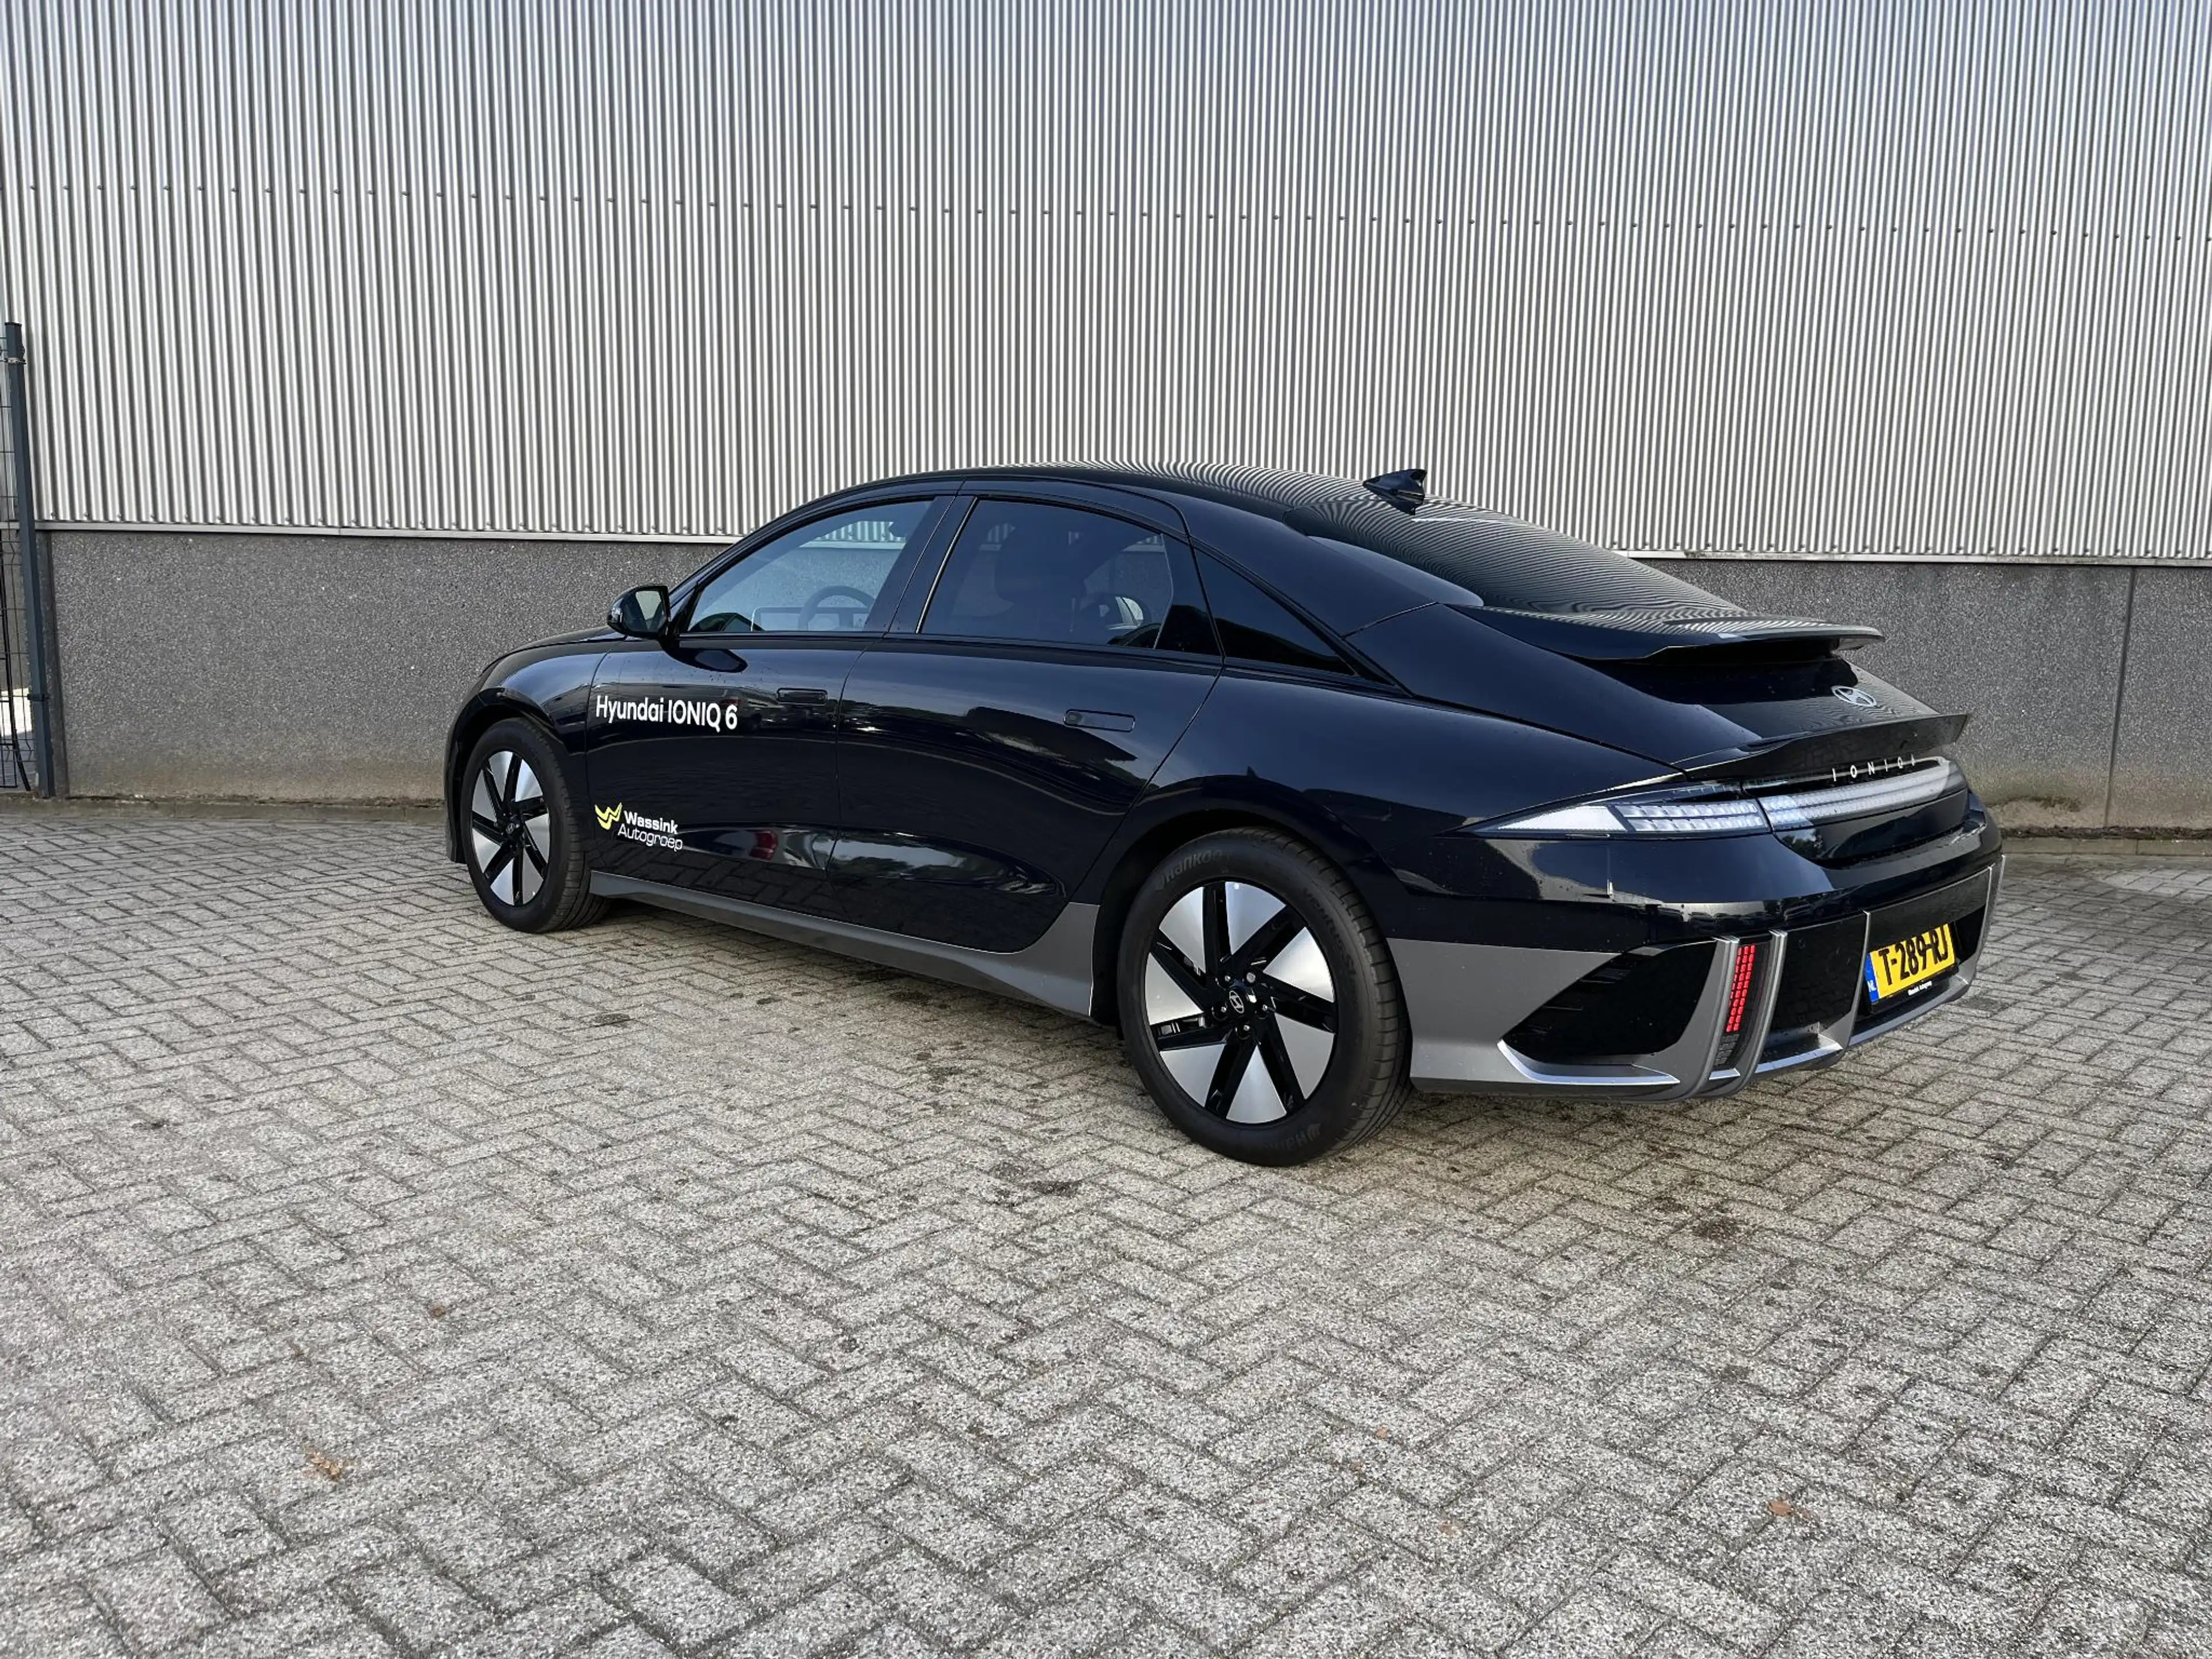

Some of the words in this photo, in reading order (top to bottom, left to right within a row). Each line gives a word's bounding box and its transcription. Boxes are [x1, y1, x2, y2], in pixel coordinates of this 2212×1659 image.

[596, 695, 664, 724] Hyundai
[668, 699, 721, 733] IONIQ
[725, 704, 738, 730] 6
[623, 809, 678, 835] Wassink
[618, 823, 683, 852] Autogroep
[1878, 926, 1949, 986] T-289-RJ
[1867, 979, 1877, 993] NL
